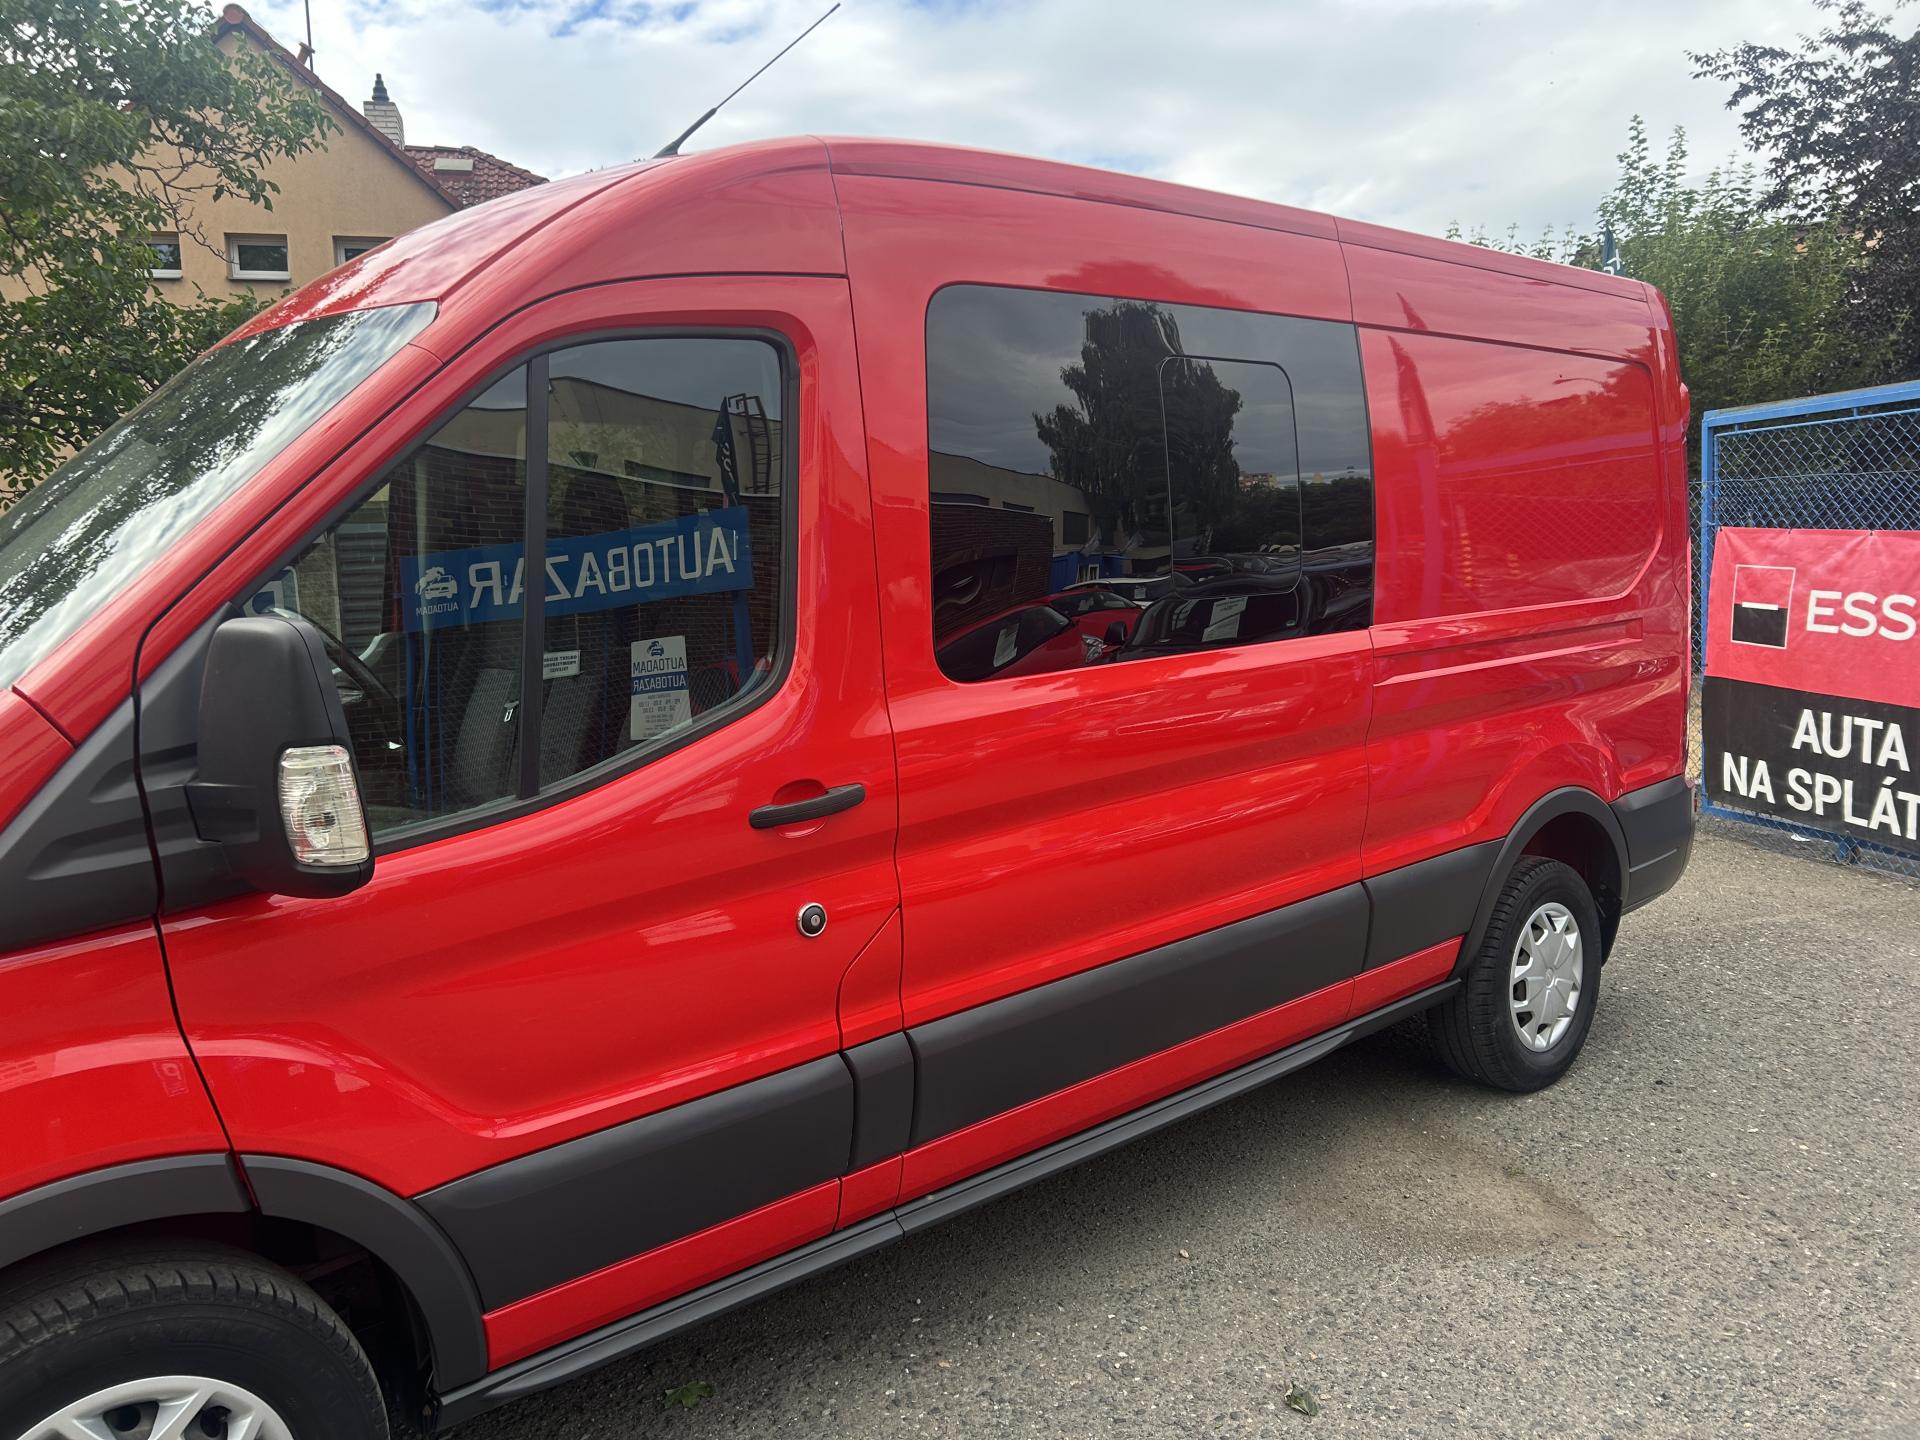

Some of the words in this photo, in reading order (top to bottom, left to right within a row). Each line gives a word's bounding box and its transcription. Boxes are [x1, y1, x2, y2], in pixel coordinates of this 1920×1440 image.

[1806, 589, 1918, 641] ESS
[1791, 708, 1911, 773] AUTA
[1723, 751, 1776, 805] NA
